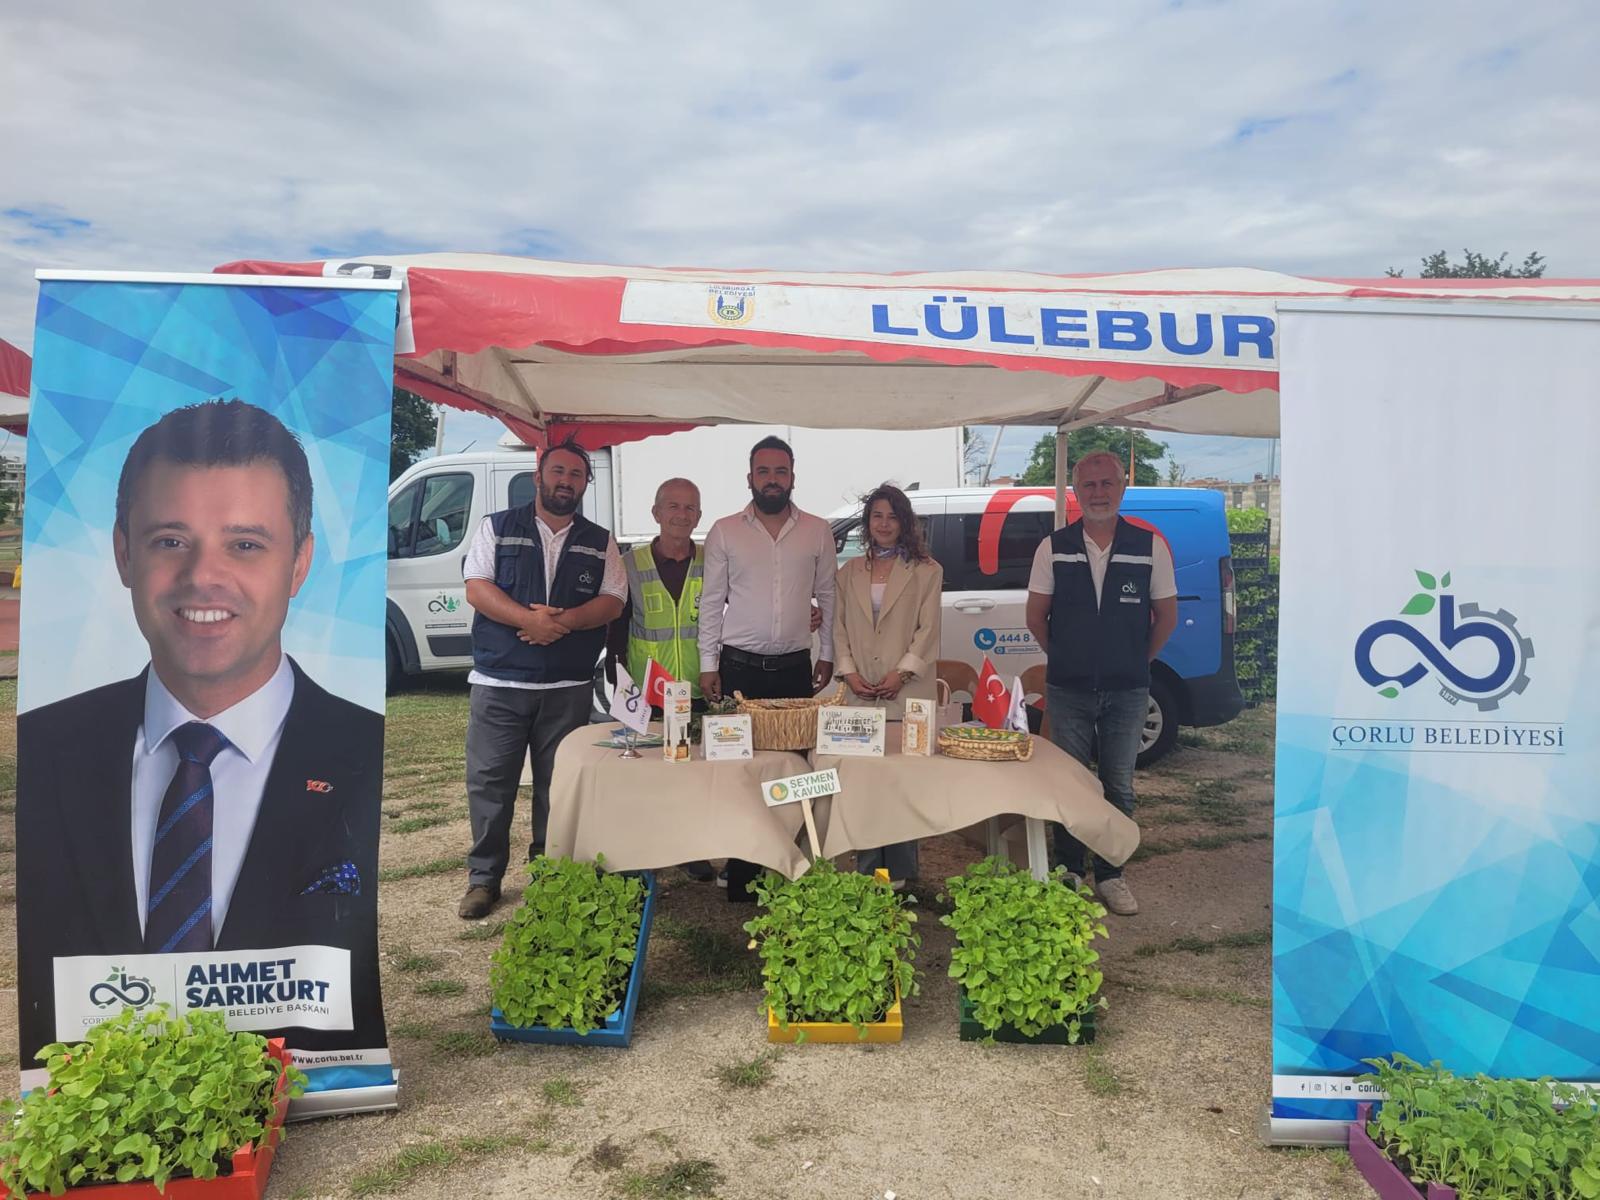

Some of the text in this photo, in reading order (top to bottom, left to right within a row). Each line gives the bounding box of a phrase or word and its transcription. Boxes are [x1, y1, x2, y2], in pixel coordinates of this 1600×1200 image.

[872, 296, 1275, 359] LÜLEBUR
[999, 634, 1021, 642] 444
[1332, 726, 1564, 747] ÇORLU BELEDİYESİ
[790, 772, 834, 788] SEYMEN
[793, 782, 835, 798] KAVUNU
[185, 959, 296, 985] AHMET
[186, 980, 330, 1008] SARIKURT
[229, 1004, 329, 1017] BELEDİYE BAŞKANI
